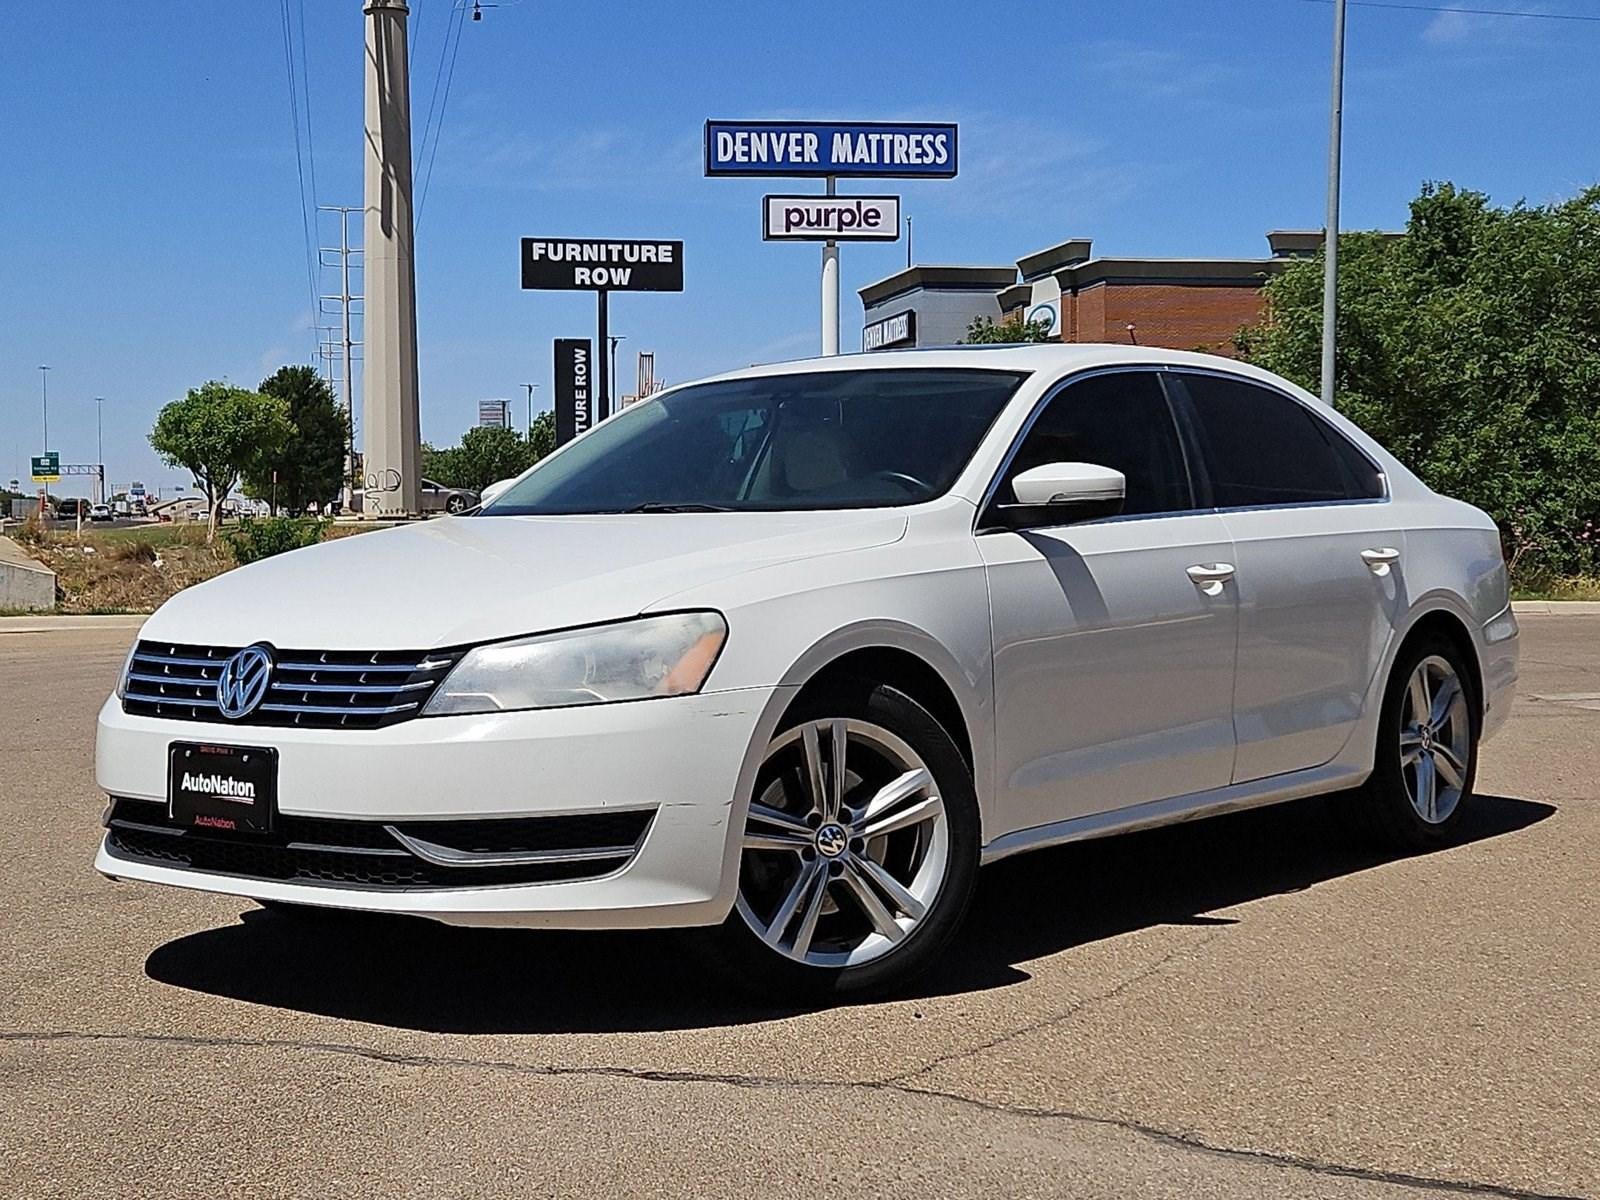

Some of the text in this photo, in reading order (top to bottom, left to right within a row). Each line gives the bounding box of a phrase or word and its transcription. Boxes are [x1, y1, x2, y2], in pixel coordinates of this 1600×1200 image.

[717, 132, 948, 165] DENVER MATTRESS
[784, 200, 881, 233] purple
[532, 242, 673, 263] FURNITURE
[574, 267, 632, 286] ROW
[574, 348, 587, 386] ROW
[181, 772, 256, 798] AutoNation
[194, 815, 235, 830] AutoNation
